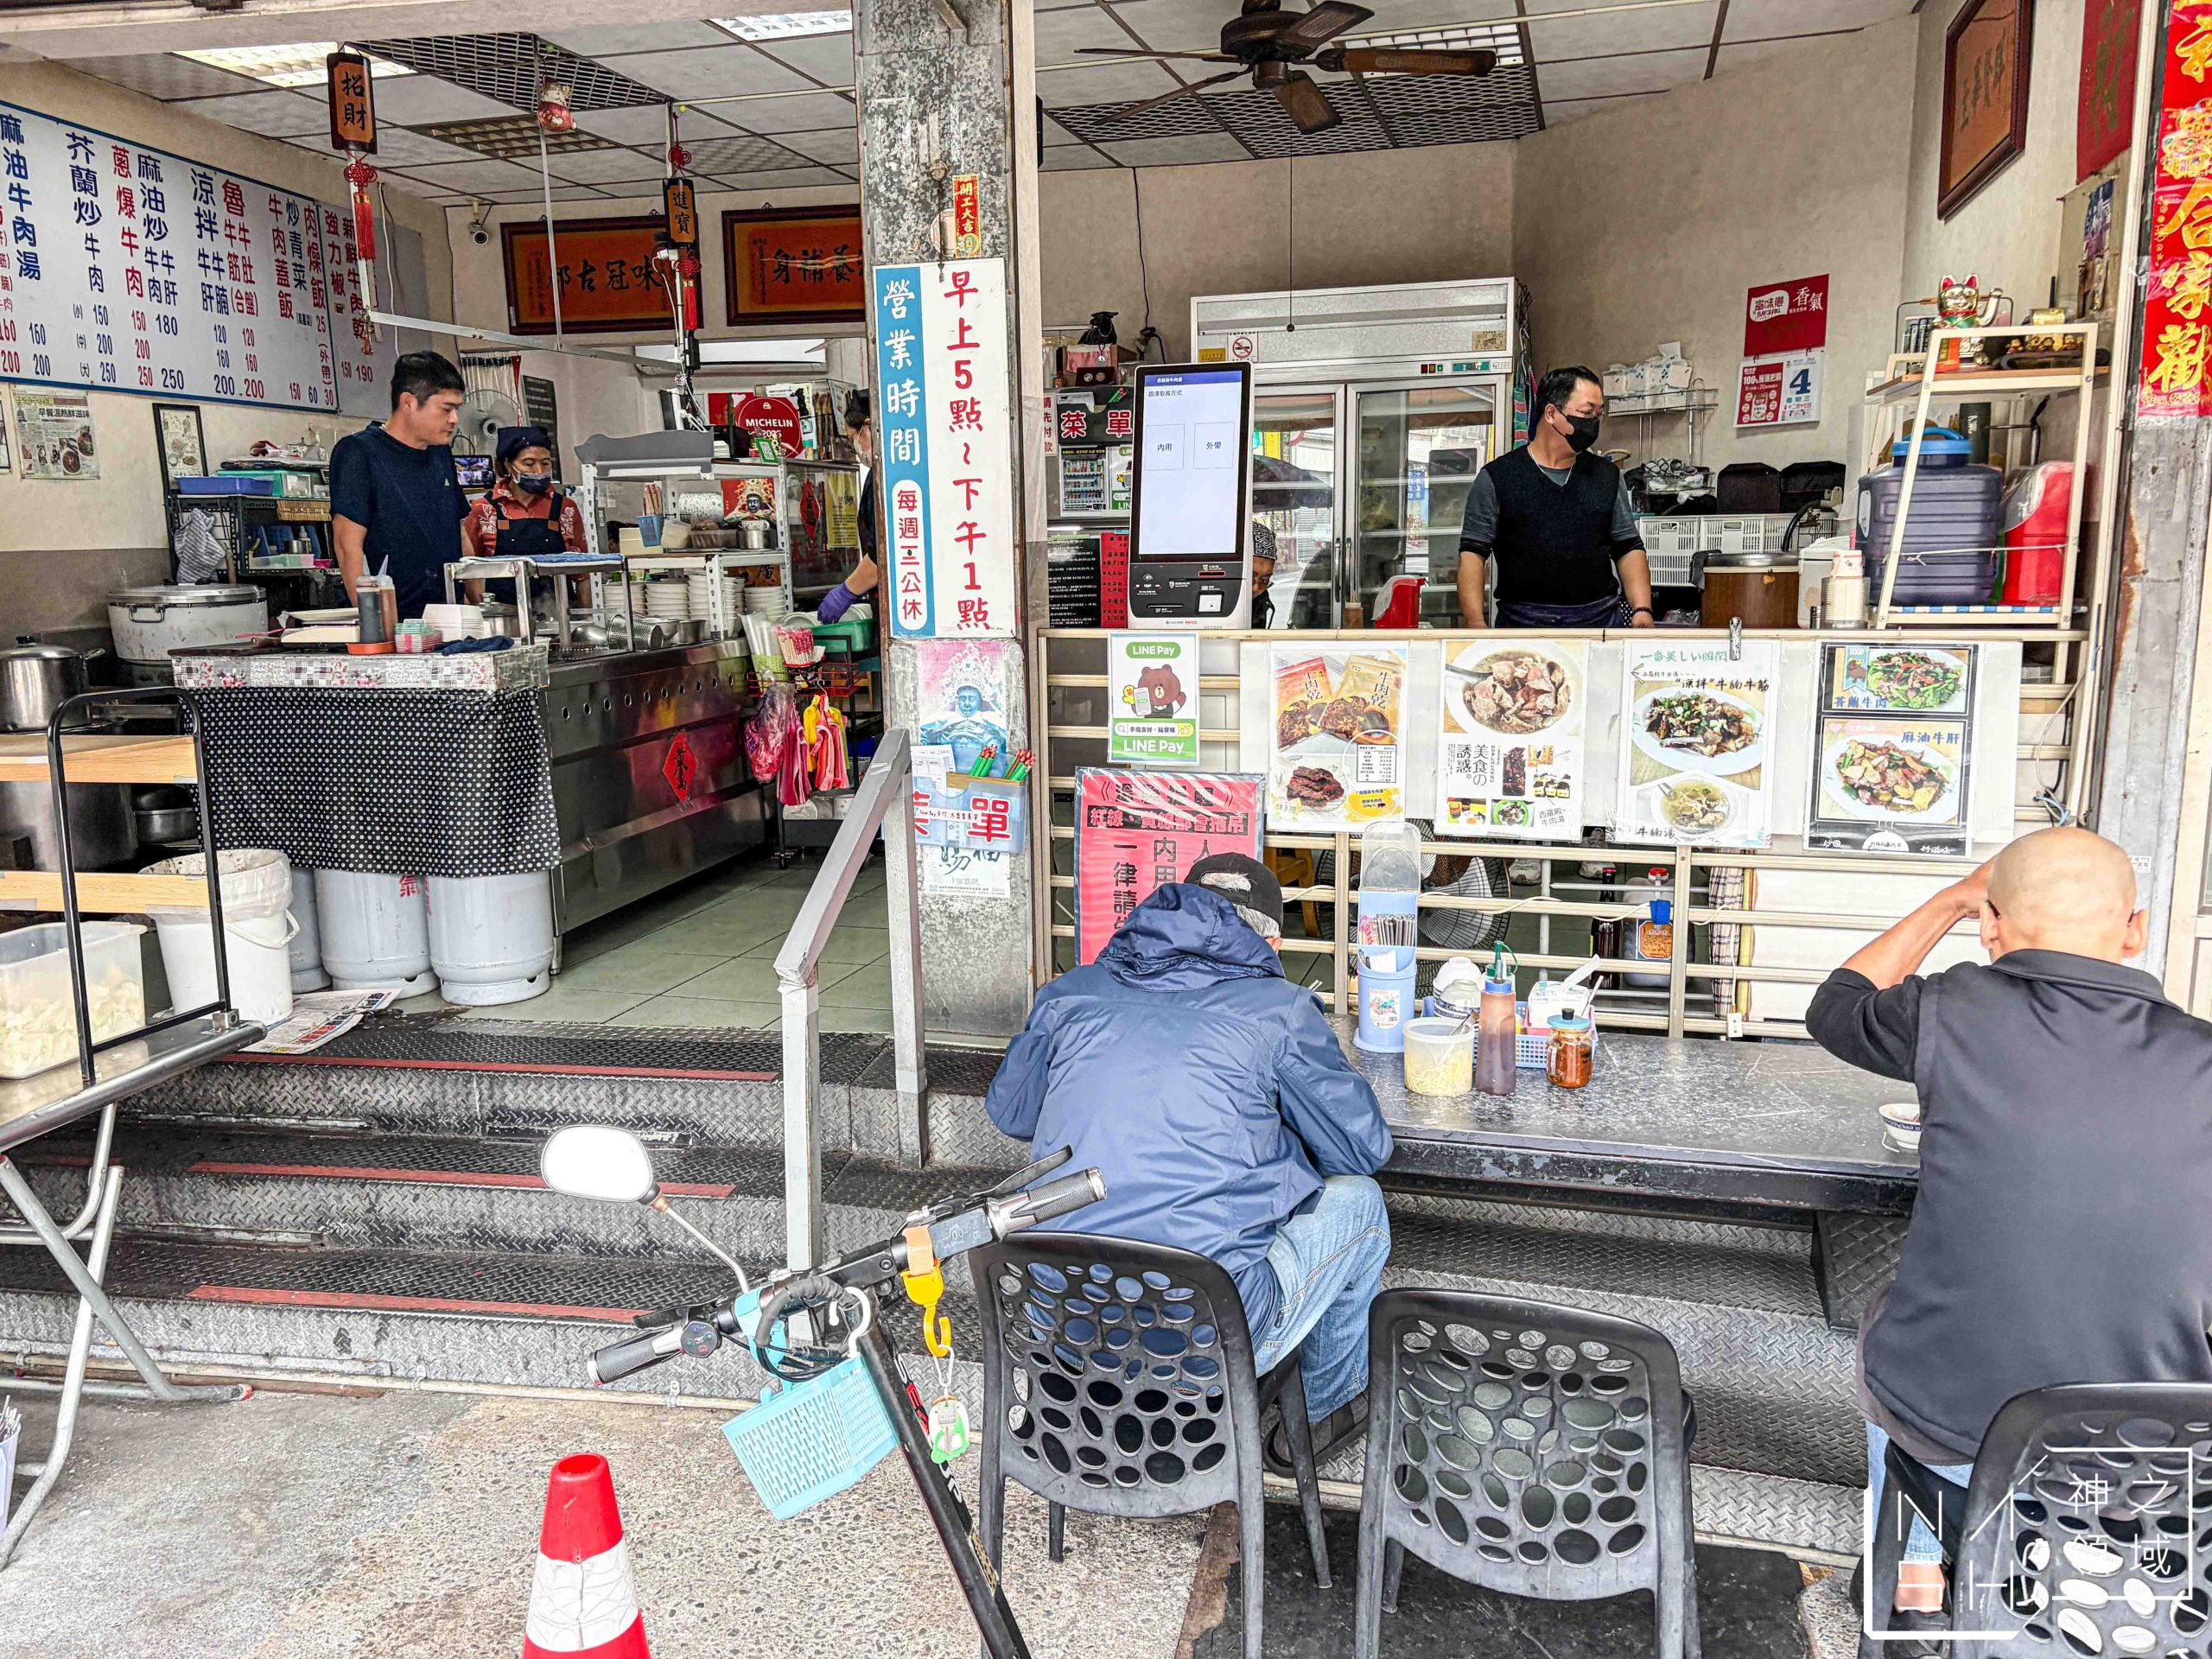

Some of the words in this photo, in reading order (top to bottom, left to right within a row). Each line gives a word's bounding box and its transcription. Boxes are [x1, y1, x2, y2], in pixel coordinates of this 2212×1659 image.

[340, 71, 367, 131] 招財
[672, 191, 690, 235] 進寶
[959, 182, 975, 233] 開工大吉
[1793, 287, 1823, 311] 香氣
[93, 304, 109, 326] 150
[131, 310, 147, 332] 150
[156, 315, 178, 336] 180
[316, 315, 326, 334] 25
[29, 322, 47, 346] 160
[97, 334, 113, 355] 200
[214, 324, 226, 344] 120
[243, 327, 255, 347] 120
[135, 339, 150, 360] 200
[217, 349, 230, 369] 160
[1, 350, 21, 373] 200
[33, 353, 51, 377] 200
[245, 353, 258, 372] 160
[341, 361, 352, 378] 150
[100, 363, 117, 384] 250
[137, 365, 154, 387] 250
[162, 369, 185, 391] 250
[356, 365, 373, 383] 190
[883, 278, 921, 467] 營業時間
[1789, 368, 1811, 395] 4
[214, 374, 235, 396] 200
[244, 378, 264, 399] 200
[289, 383, 301, 401] 150
[308, 386, 318, 404] 60
[324, 389, 334, 406] 30
[746, 418, 793, 428] MICHELIN
[1060, 410, 1133, 438] 菜單
[897, 489, 923, 621] 每週三公休
[1132, 645, 1155, 655] LINE
[1158, 646, 1175, 657] Pay
[1124, 740, 1156, 752] LINE
[1160, 740, 1185, 754] Pay
[1901, 732, 1961, 745] 麻油牛肝
[1472, 744, 1488, 786] 美食の
